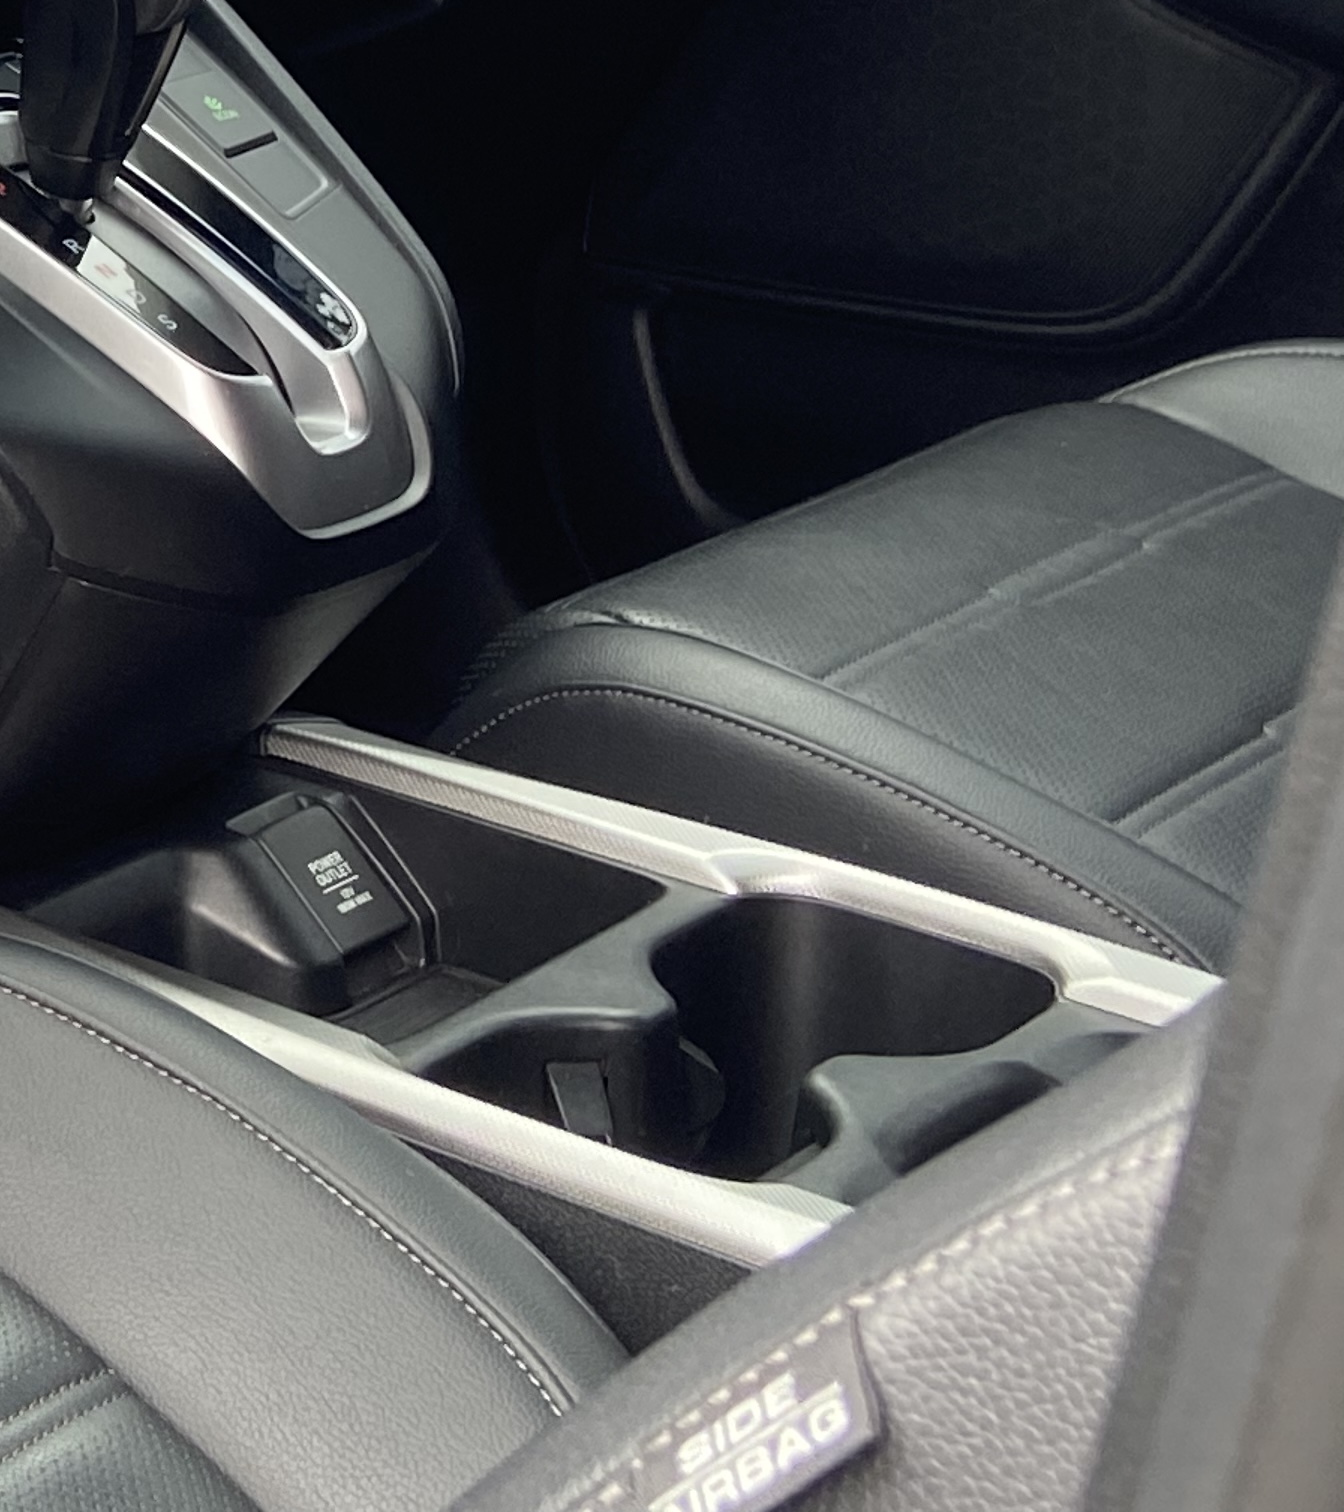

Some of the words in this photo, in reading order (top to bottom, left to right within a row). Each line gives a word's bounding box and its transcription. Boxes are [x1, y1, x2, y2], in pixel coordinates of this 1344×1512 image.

[62, 238, 85, 254] R
[315, 861, 353, 887] OUTLET
[676, 1370, 797, 1474] SIDE
